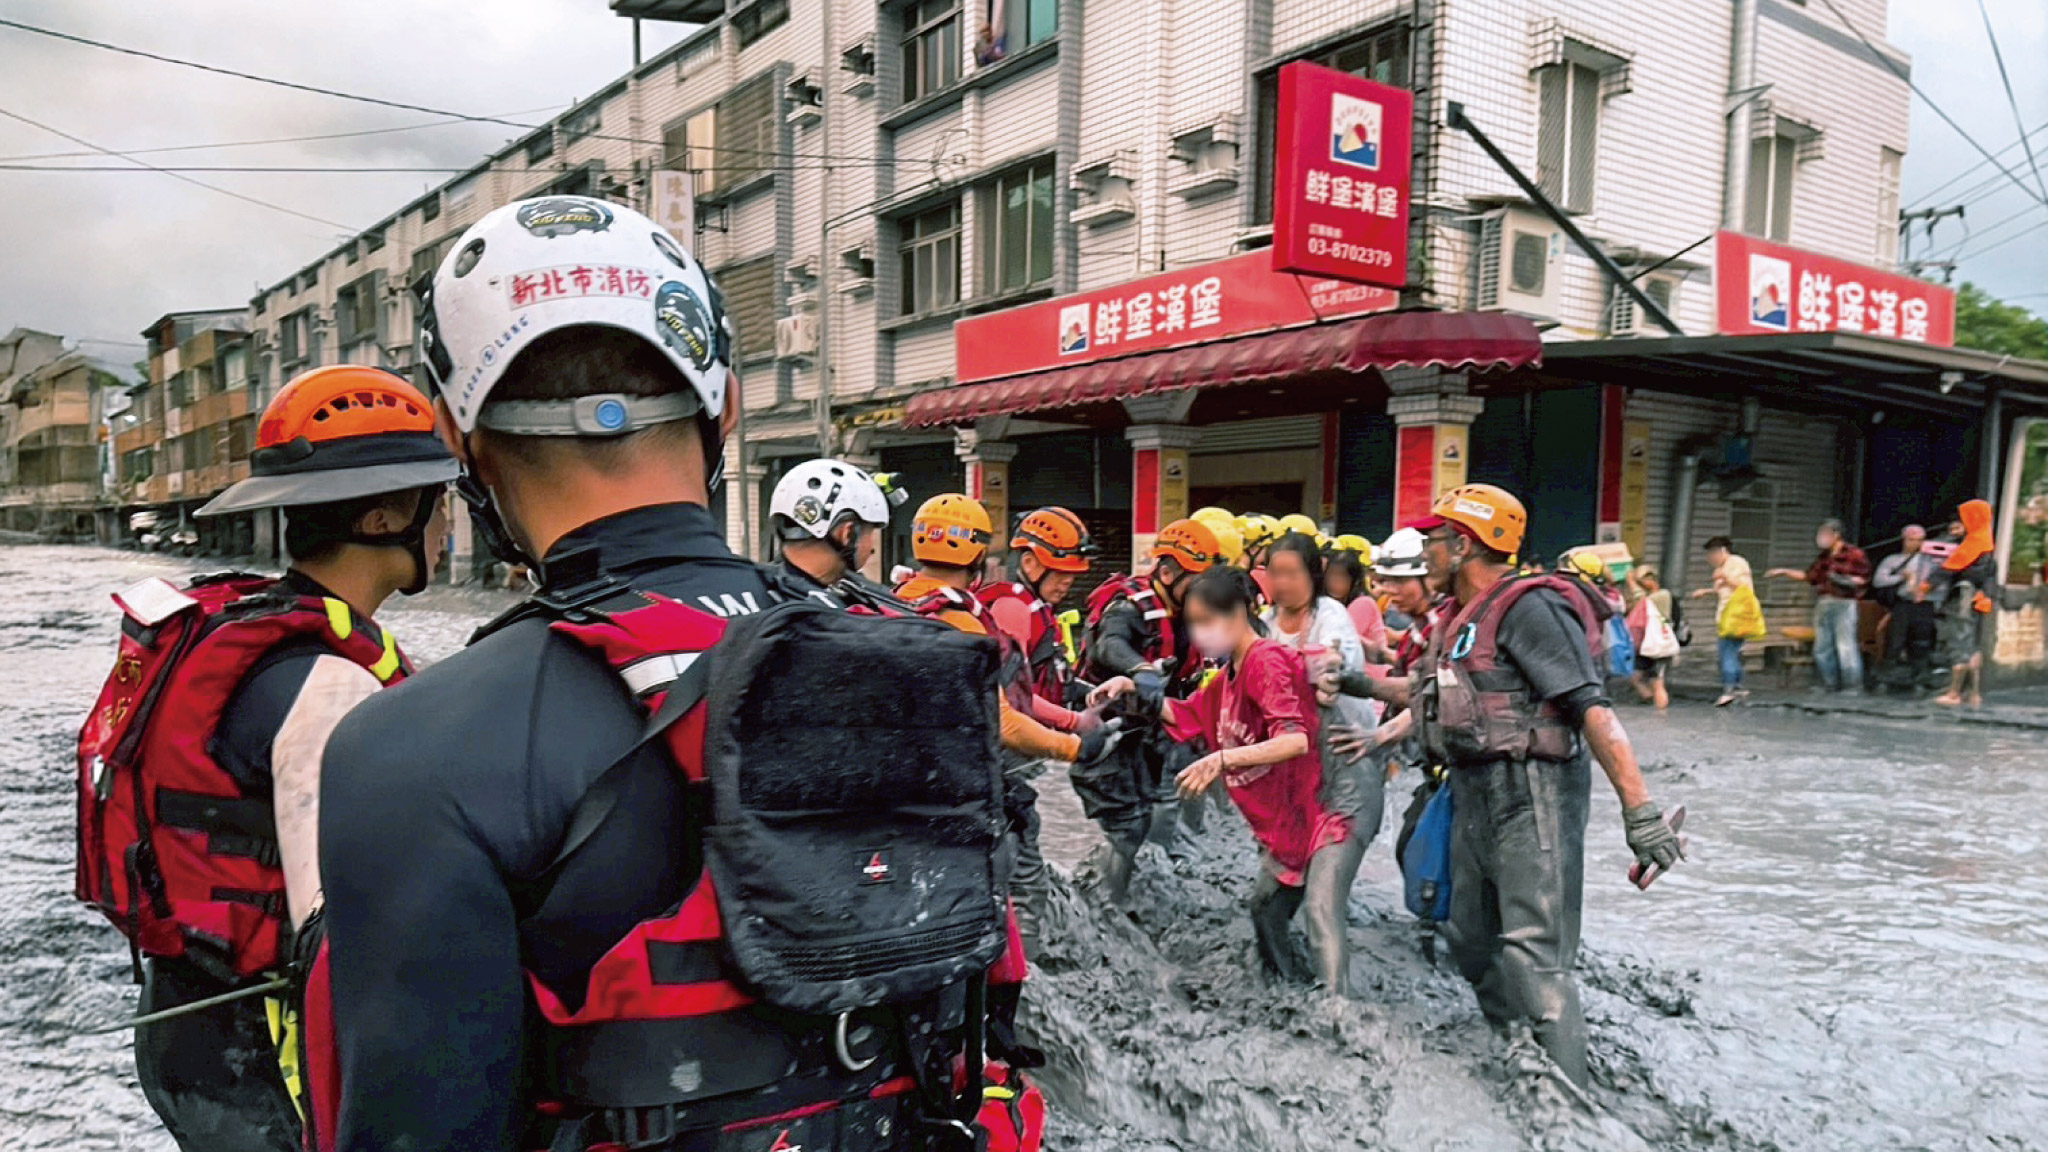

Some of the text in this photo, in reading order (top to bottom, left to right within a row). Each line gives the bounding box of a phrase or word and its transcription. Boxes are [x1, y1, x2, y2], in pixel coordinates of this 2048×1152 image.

[1305, 169, 1398, 219] 鮮堡漢堡
[1308, 237, 1392, 268] 03-8702379
[511, 266, 651, 304] 新北市消防
[1797, 270, 1928, 342] 鮮堡漢堡
[1095, 276, 1221, 345] 鮮堡漢堡
